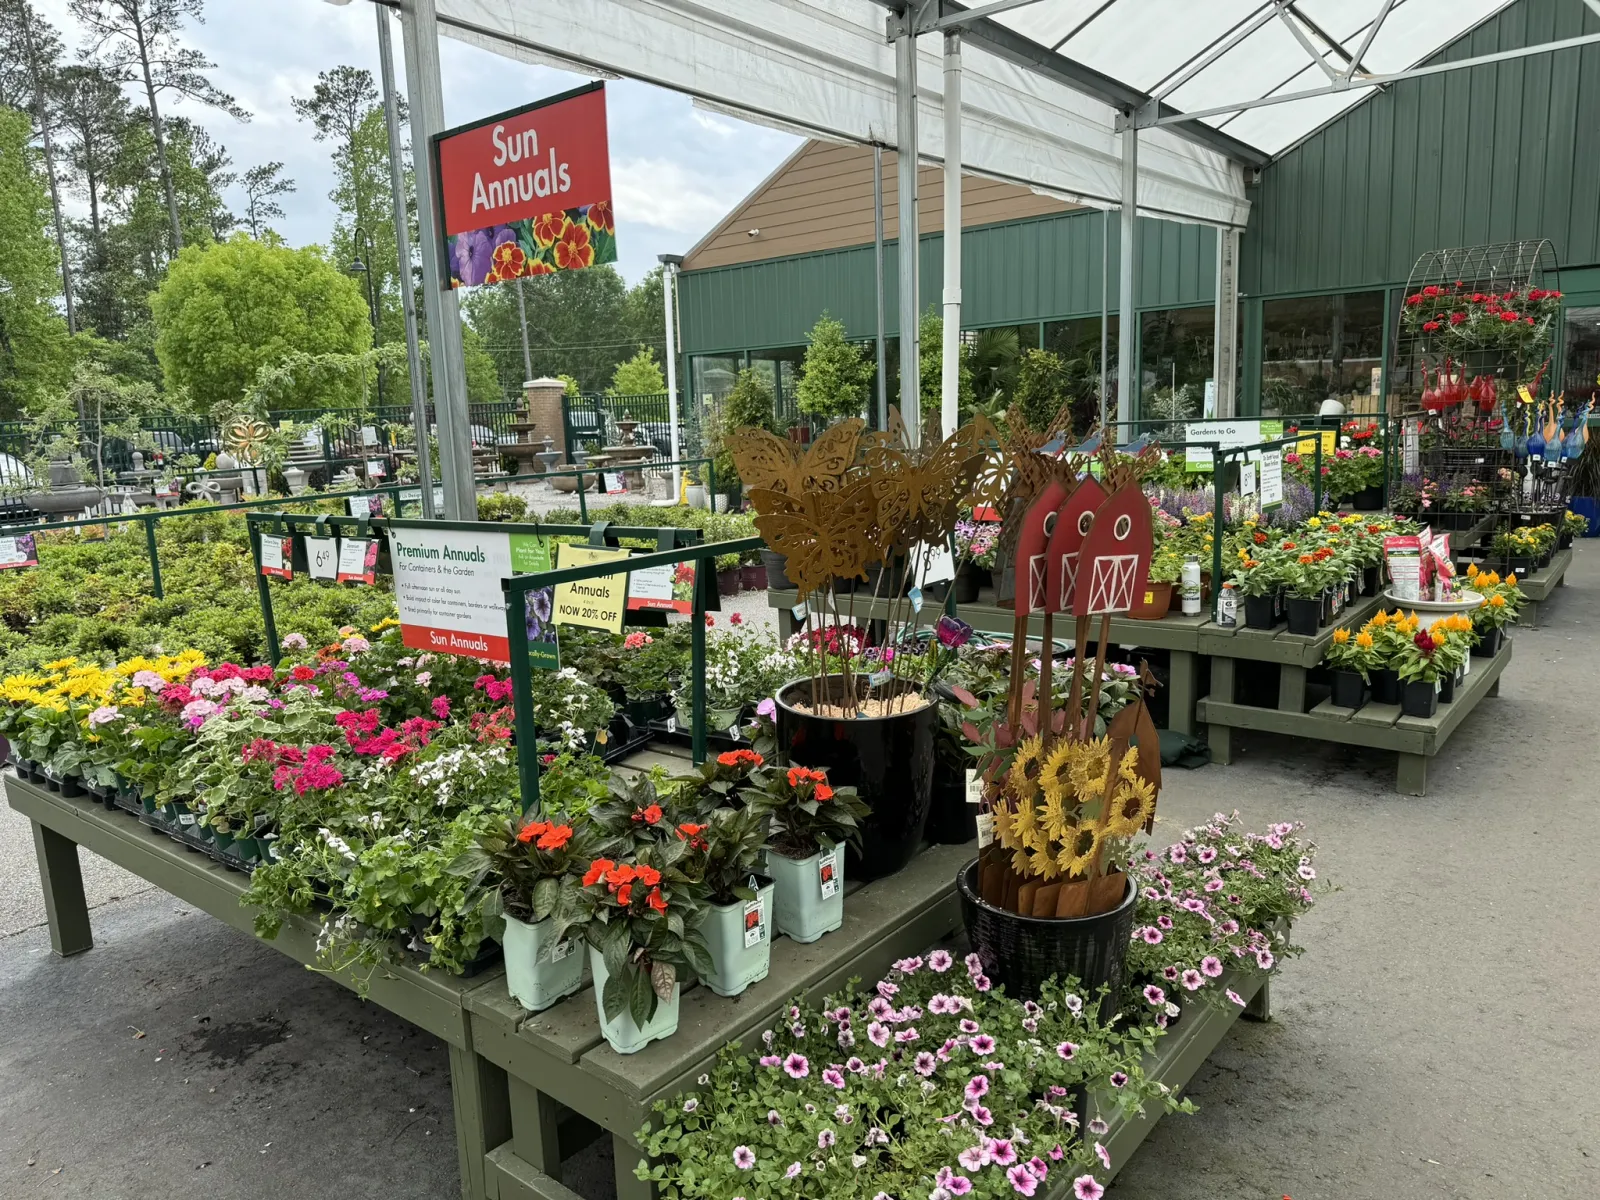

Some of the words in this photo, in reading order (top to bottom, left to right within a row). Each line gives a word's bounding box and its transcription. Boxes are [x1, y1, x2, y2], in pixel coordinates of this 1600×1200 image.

[492, 125, 538, 166] Sun
[472, 147, 571, 213] Annuals
[396, 542, 440, 560] Premium
[443, 545, 485, 562] Annuals
[399, 562, 407, 570] For
[408, 563, 436, 573] Containers
[437, 565, 442, 573] &
[443, 565, 451, 574] the
[453, 566, 474, 576] Garden
[570, 582, 610, 598] Annuals
[489, 604, 506, 612] walkway
[559, 605, 580, 616] NOW
[582, 608, 598, 620] 20%
[600, 611, 617, 622] OFF
[430, 631, 447, 645] Sun
[450, 633, 488, 651] Annuals
